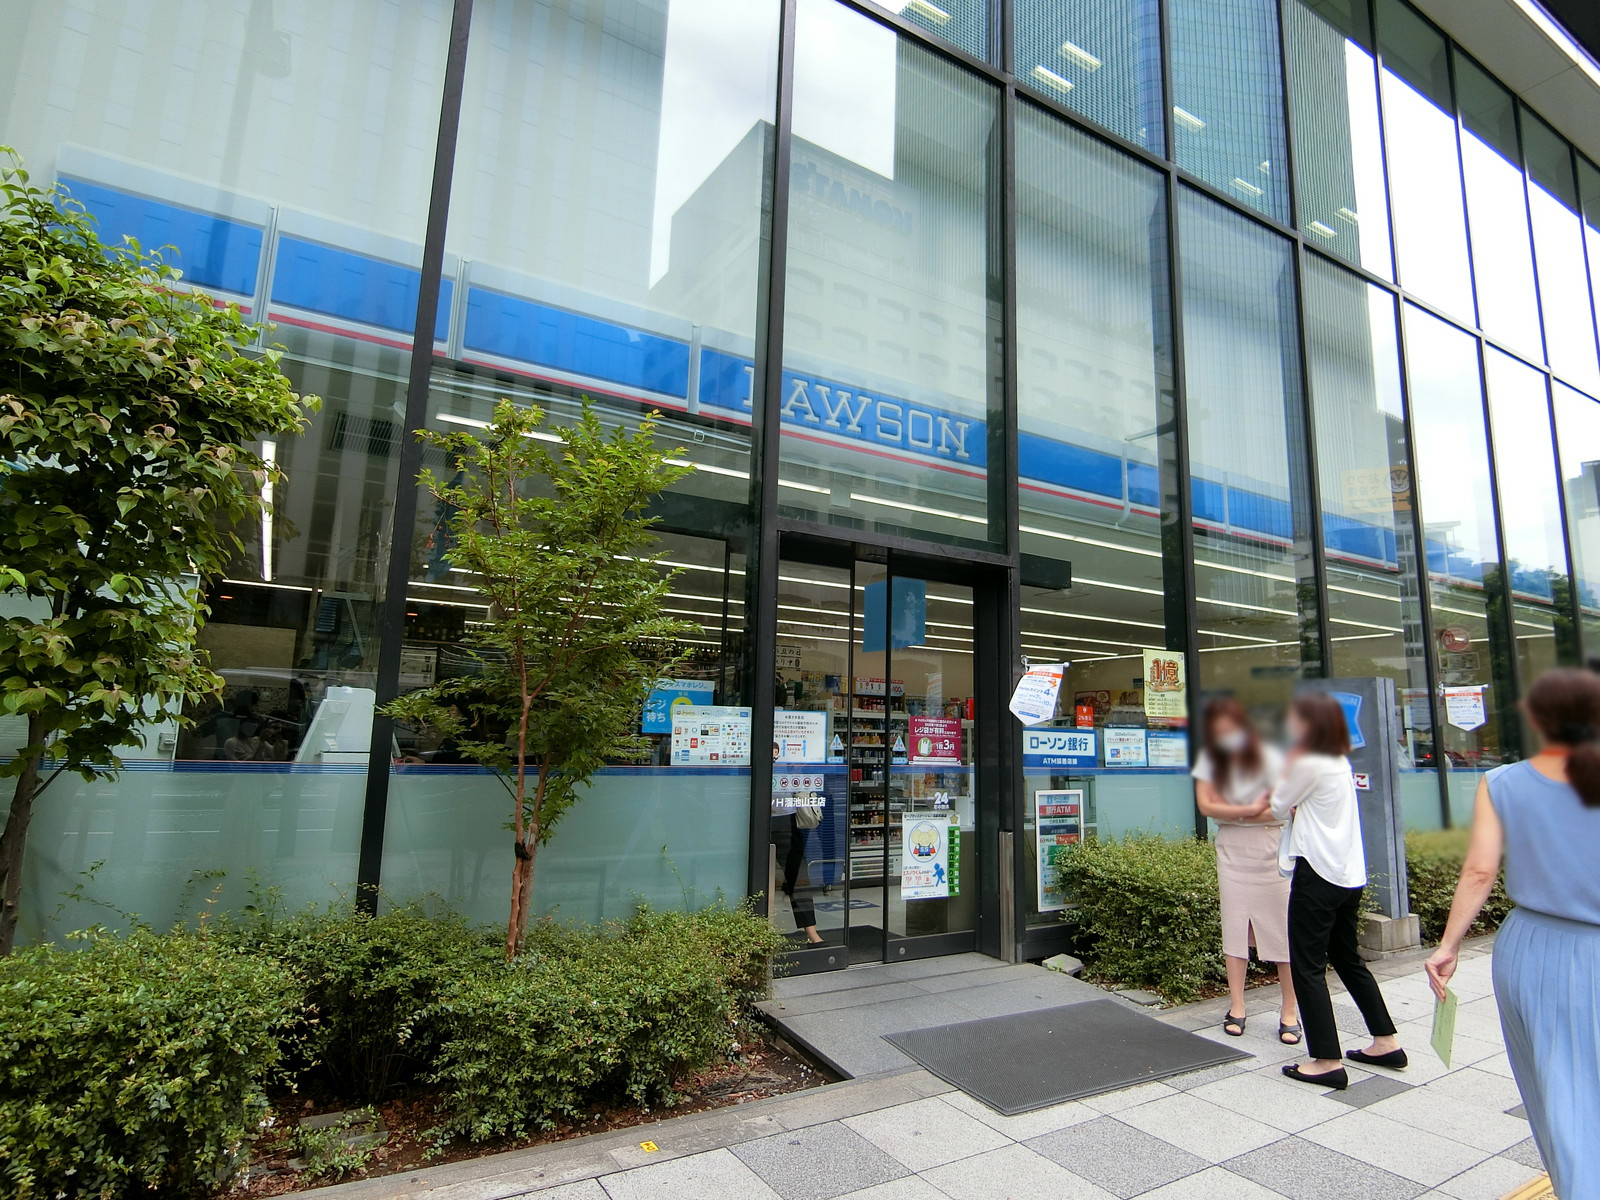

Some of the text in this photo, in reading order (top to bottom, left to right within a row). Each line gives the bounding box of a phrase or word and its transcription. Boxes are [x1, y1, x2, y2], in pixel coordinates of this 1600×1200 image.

[646, 711, 666, 722] 待ち
[1029, 736, 1089, 751] ローソン銀行
[934, 791, 949, 804] 24
